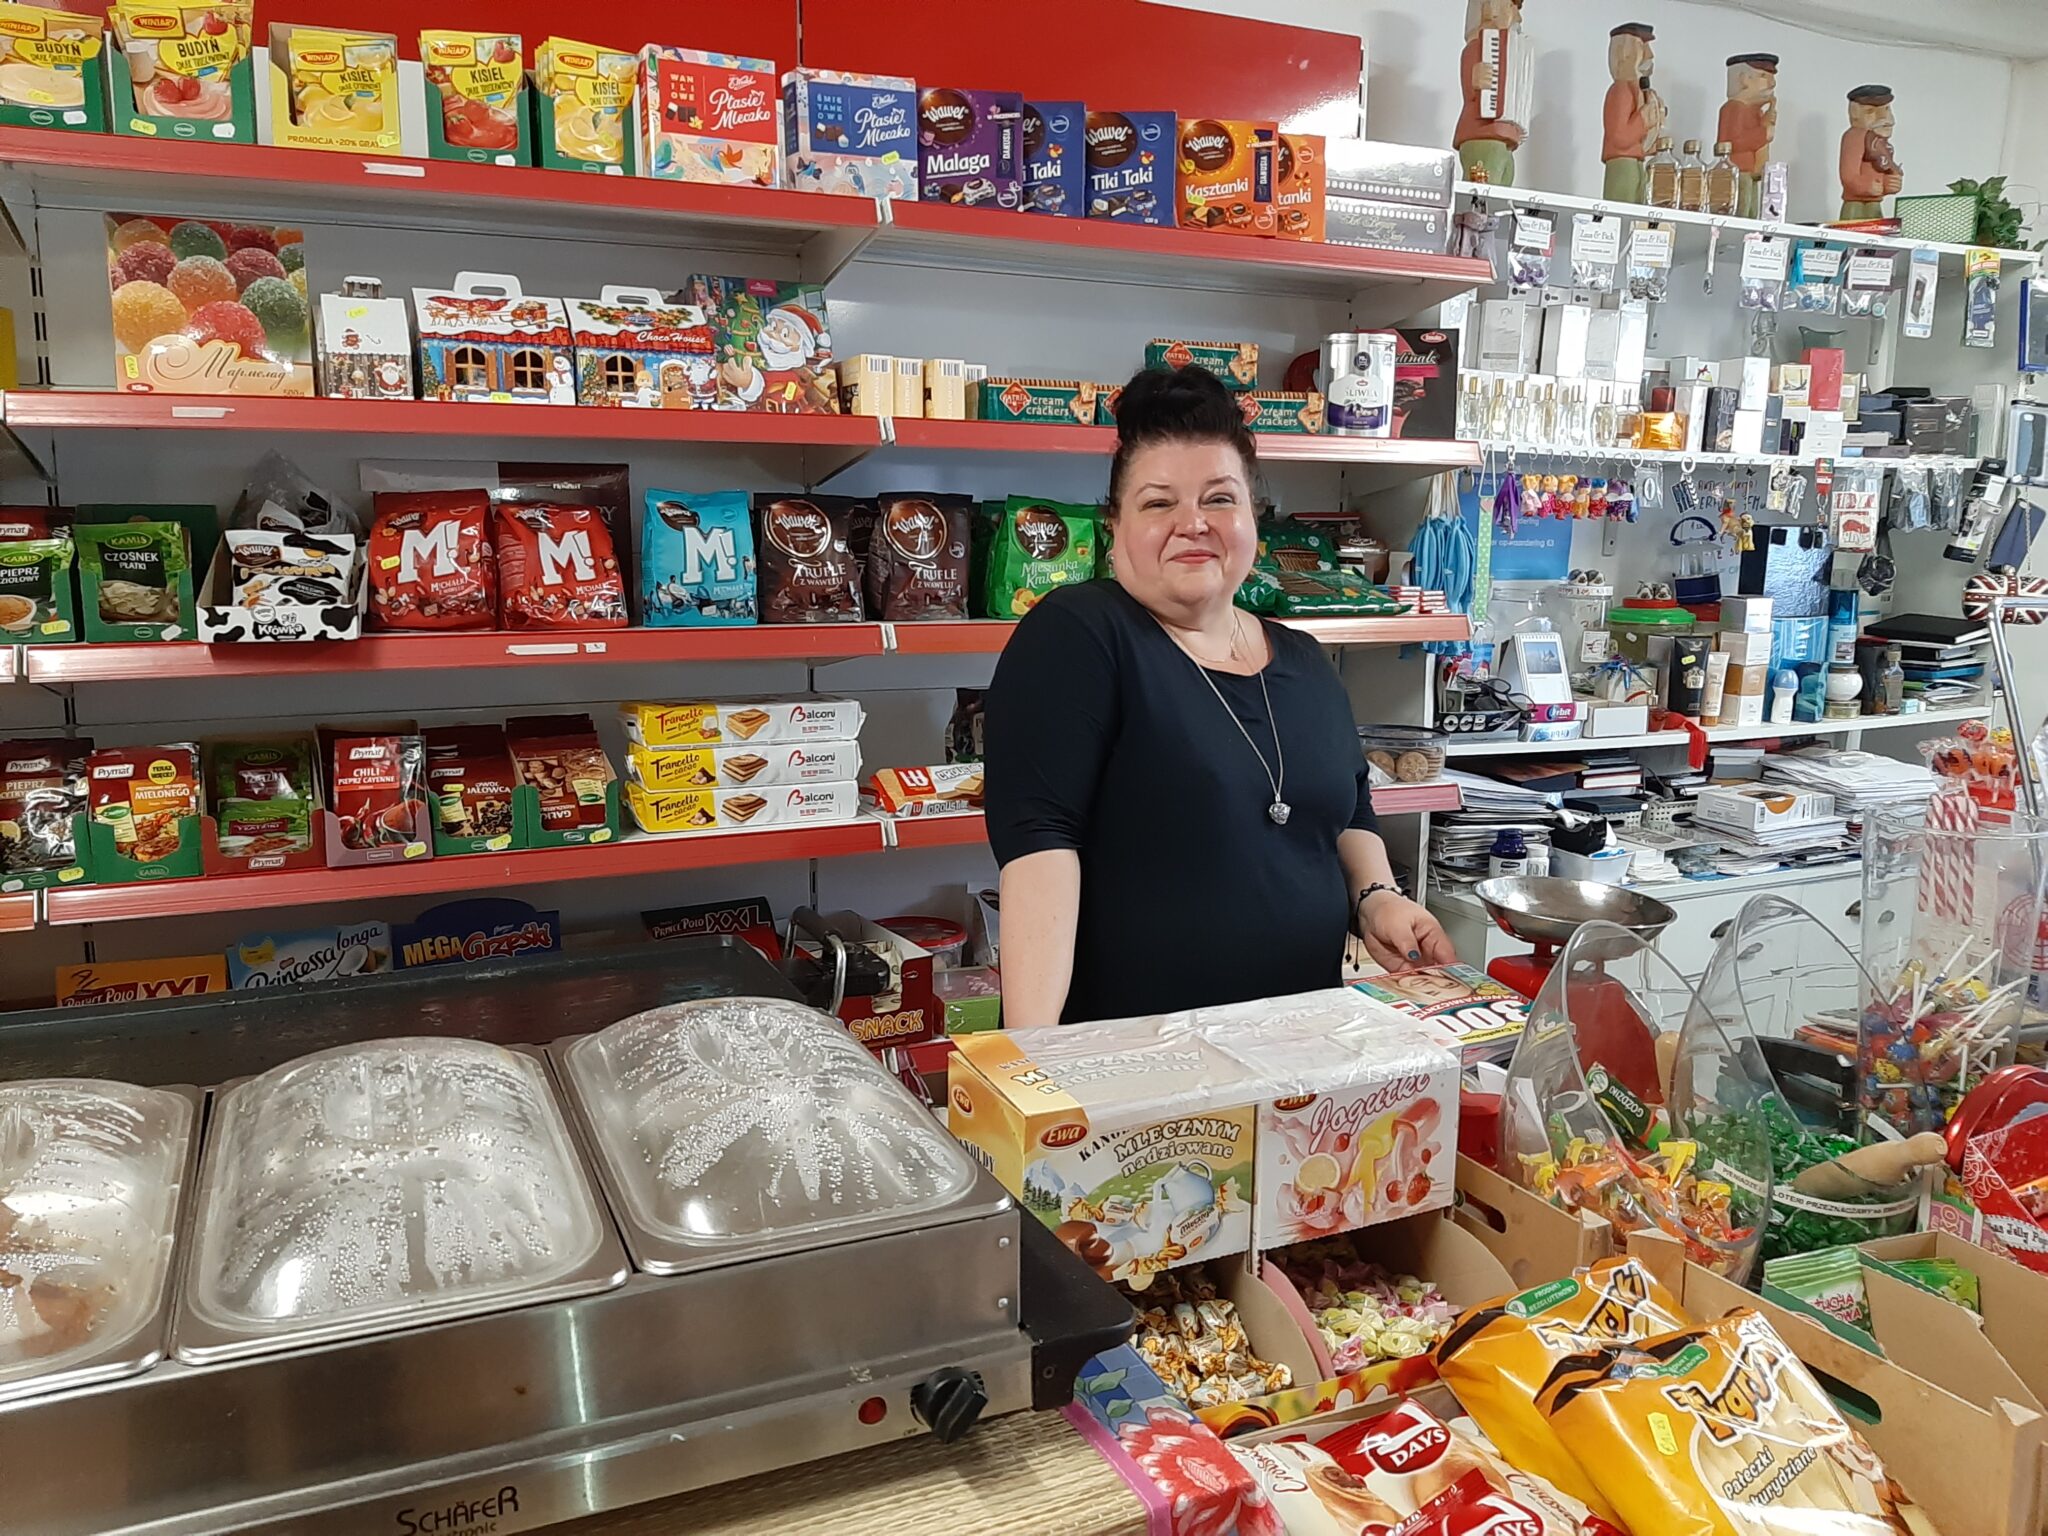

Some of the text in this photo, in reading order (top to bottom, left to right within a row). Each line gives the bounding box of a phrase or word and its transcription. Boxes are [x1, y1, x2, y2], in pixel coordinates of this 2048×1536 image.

[34, 42, 82, 56] BUDYŃ
[176, 36, 221, 58] BUDYŃ
[340, 70, 375, 84] KISIEL
[470, 67, 505, 84] KISIEL
[592, 82, 620, 96] KISIEL
[709, 88, 765, 115] Ptasie
[710, 107, 771, 131] Mleczko
[854, 108, 906, 133] Ptasie
[287, 135, 334, 145] PROMOCJA
[855, 126, 911, 150] Mleczko
[926, 153, 991, 176] Malaga
[1030, 159, 1062, 180] Taki
[1091, 166, 1153, 191] Tiki Taki
[1185, 177, 1249, 198] Kasztanki
[1193, 357, 1224, 366] cream
[1026, 405, 1070, 416] crackers
[1032, 397, 1065, 406] cream
[1256, 416, 1298, 427] crackers
[0, 526, 26, 536] rymat
[110, 534, 148, 546] KAMIS
[2, 555, 39, 564] KAMIS
[104, 552, 160, 563] CZOSNEK
[682, 526, 738, 585] M!
[1, 566, 40, 577] PIEPRZ
[119, 562, 147, 570] PŁATKI
[790, 561, 847, 586] TRUFLE
[909, 564, 958, 589] TRUFLE
[258, 624, 303, 636] Krówka
[789, 706, 836, 724] Balconi
[1443, 714, 1486, 731] OCB
[353, 749, 382, 759] Prymat
[787, 750, 836, 769] Balconi
[97, 767, 130, 778] Prymat
[353, 767, 380, 777] CHILI
[432, 768, 462, 777] Prymat
[6, 780, 46, 791] PIEPRZ
[134, 788, 190, 800] MIELONEGO
[786, 788, 835, 808] Balconi
[253, 858, 282, 868] Prymat
[705, 905, 772, 934] XXL
[336, 925, 384, 952] longa
[402, 922, 553, 967] MEGA Grześki
[1413, 995, 1520, 1020] PANORAMICZNYC
[849, 1009, 925, 1041] SNACK
[1434, 1000, 1530, 1038] 300
[1609, 1086, 1645, 1119] GOŹDZIKI
[1048, 1125, 1081, 1142] Ewa
[1113, 1117, 1242, 1162] MLECZNYM
[959, 1141, 997, 1174] ANOLDY
[1121, 1140, 1235, 1178] nadziewane
[1389, 1424, 1449, 1468] DAYS
[1722, 1445, 1775, 1500] Pałeczki
[396, 1486, 519, 1536] SCHÄFER
